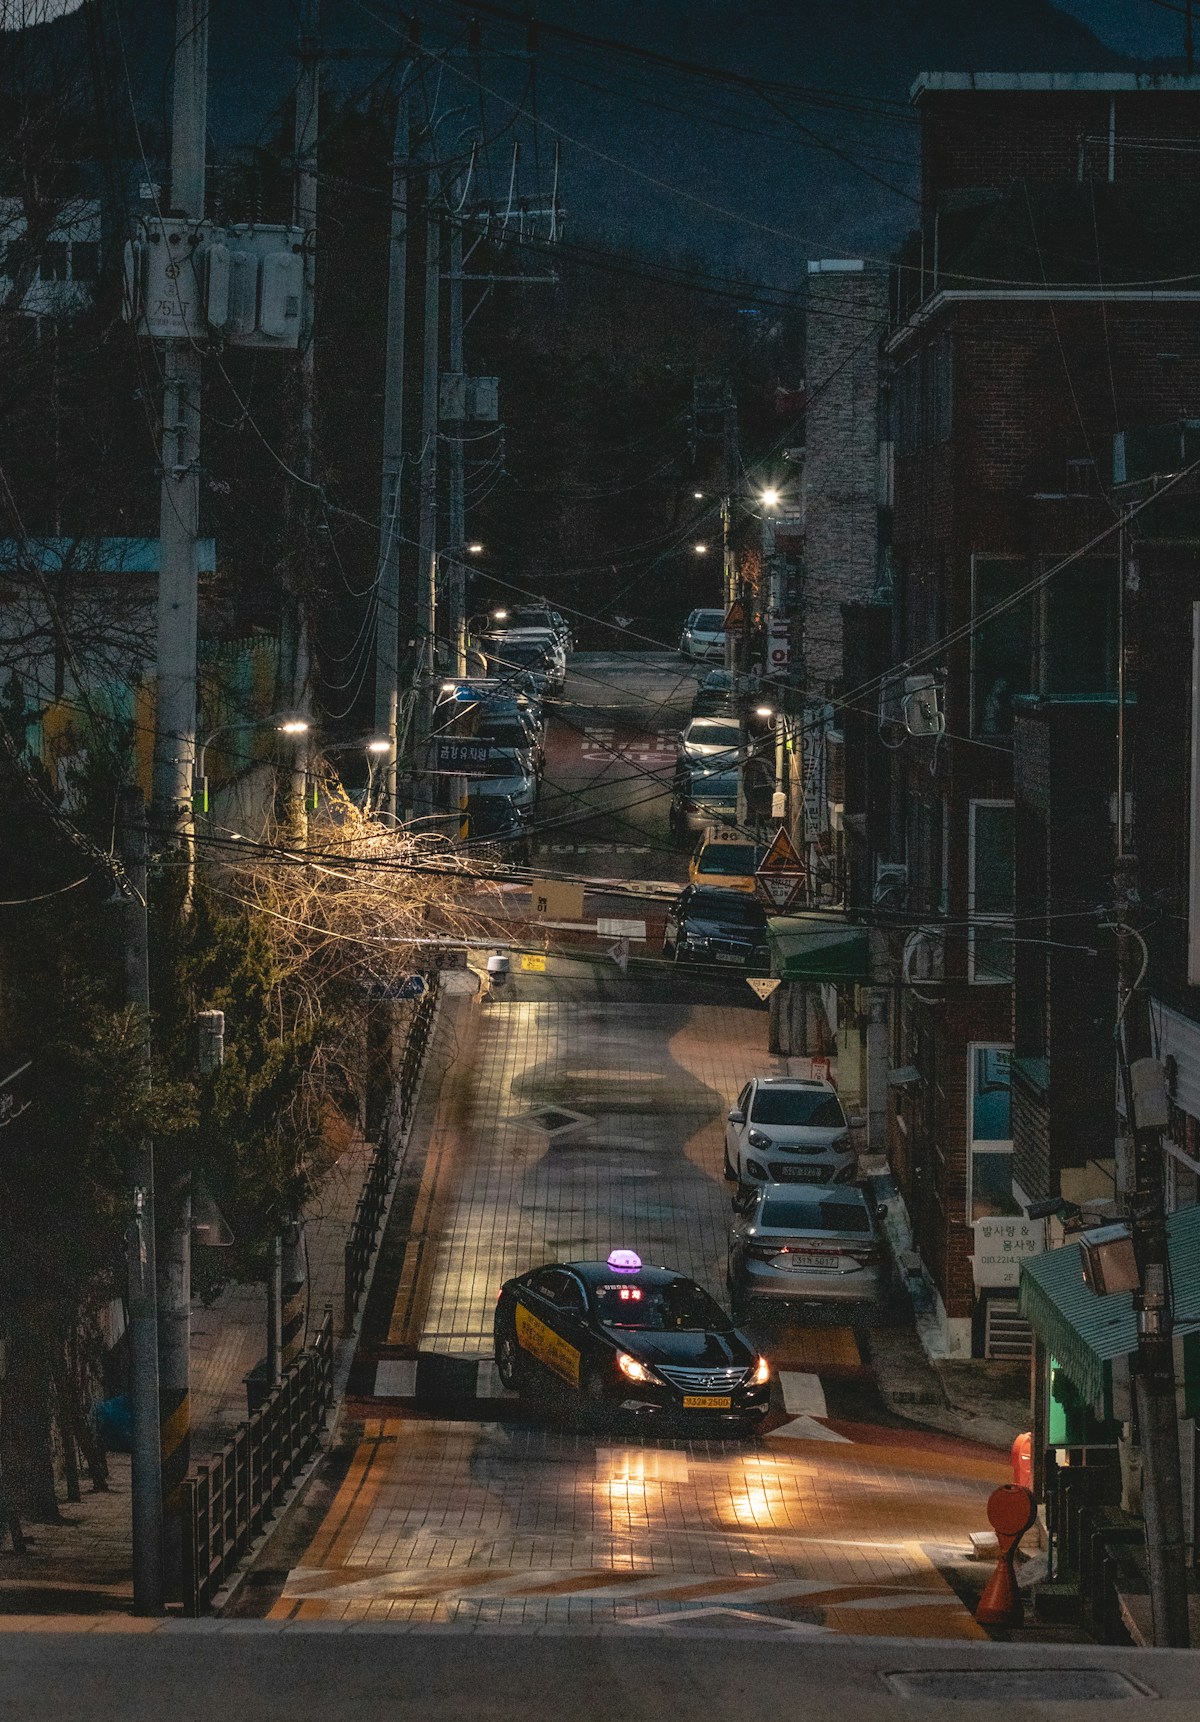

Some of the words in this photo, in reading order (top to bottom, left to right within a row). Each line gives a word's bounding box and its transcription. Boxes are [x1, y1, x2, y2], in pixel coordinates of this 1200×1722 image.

[982, 1226, 1016, 1238] 발사랑
[1021, 1226, 1030, 1236] &
[1003, 1273, 1014, 1281] 2F
